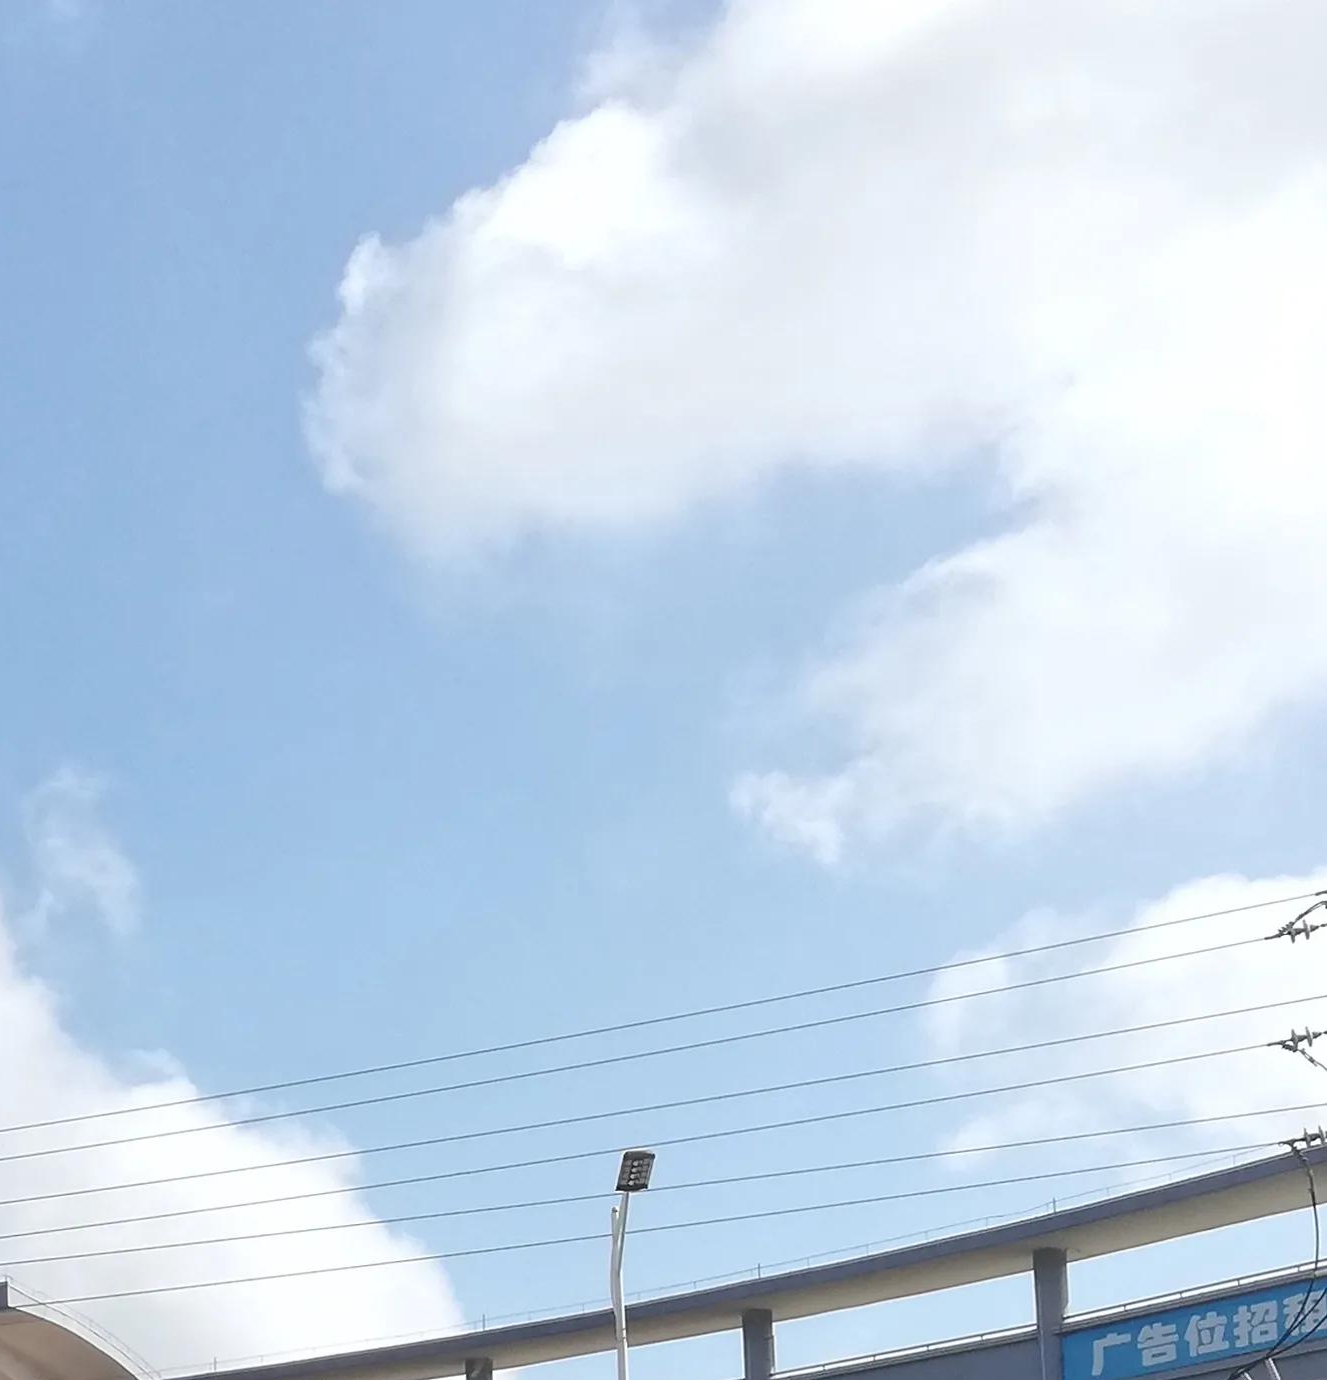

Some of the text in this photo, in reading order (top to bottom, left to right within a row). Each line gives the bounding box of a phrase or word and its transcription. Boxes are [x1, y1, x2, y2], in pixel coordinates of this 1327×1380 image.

[1091, 1290, 1327, 1377] 广告位招租
